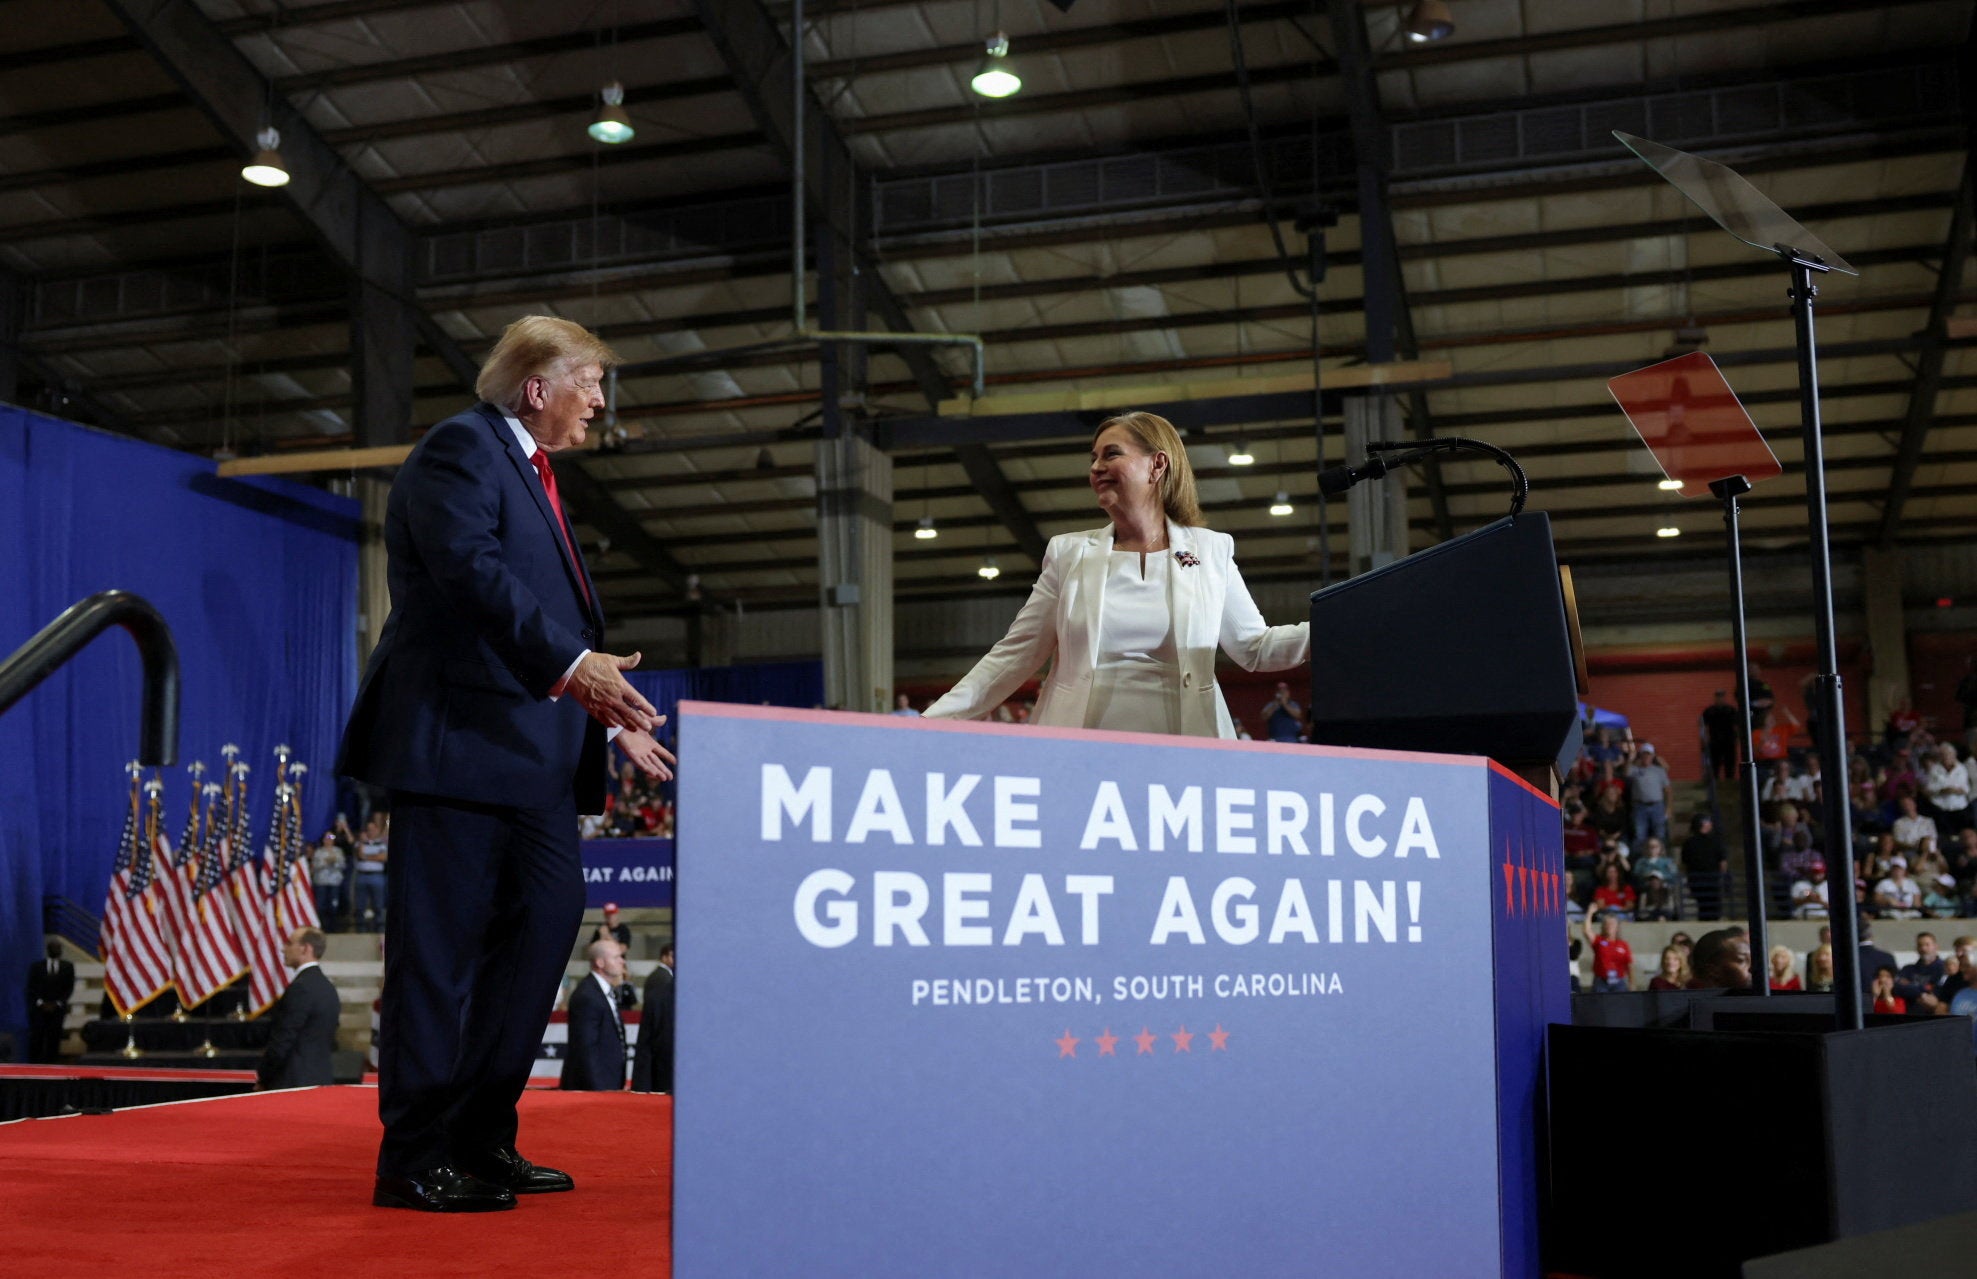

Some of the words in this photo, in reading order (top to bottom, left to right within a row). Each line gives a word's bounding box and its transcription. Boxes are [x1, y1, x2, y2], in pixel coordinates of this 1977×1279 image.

[760, 763, 1042, 848] MAKE
[1080, 780, 1441, 860] AMERICA
[794, 868, 1114, 948] GREAT
[1150, 876, 1423, 946] AGAIN!
[911, 977, 1101, 1005] PENDLETON,
[1112, 974, 1207, 1001] SOUTH
[1213, 972, 1346, 998] CAROLINA
